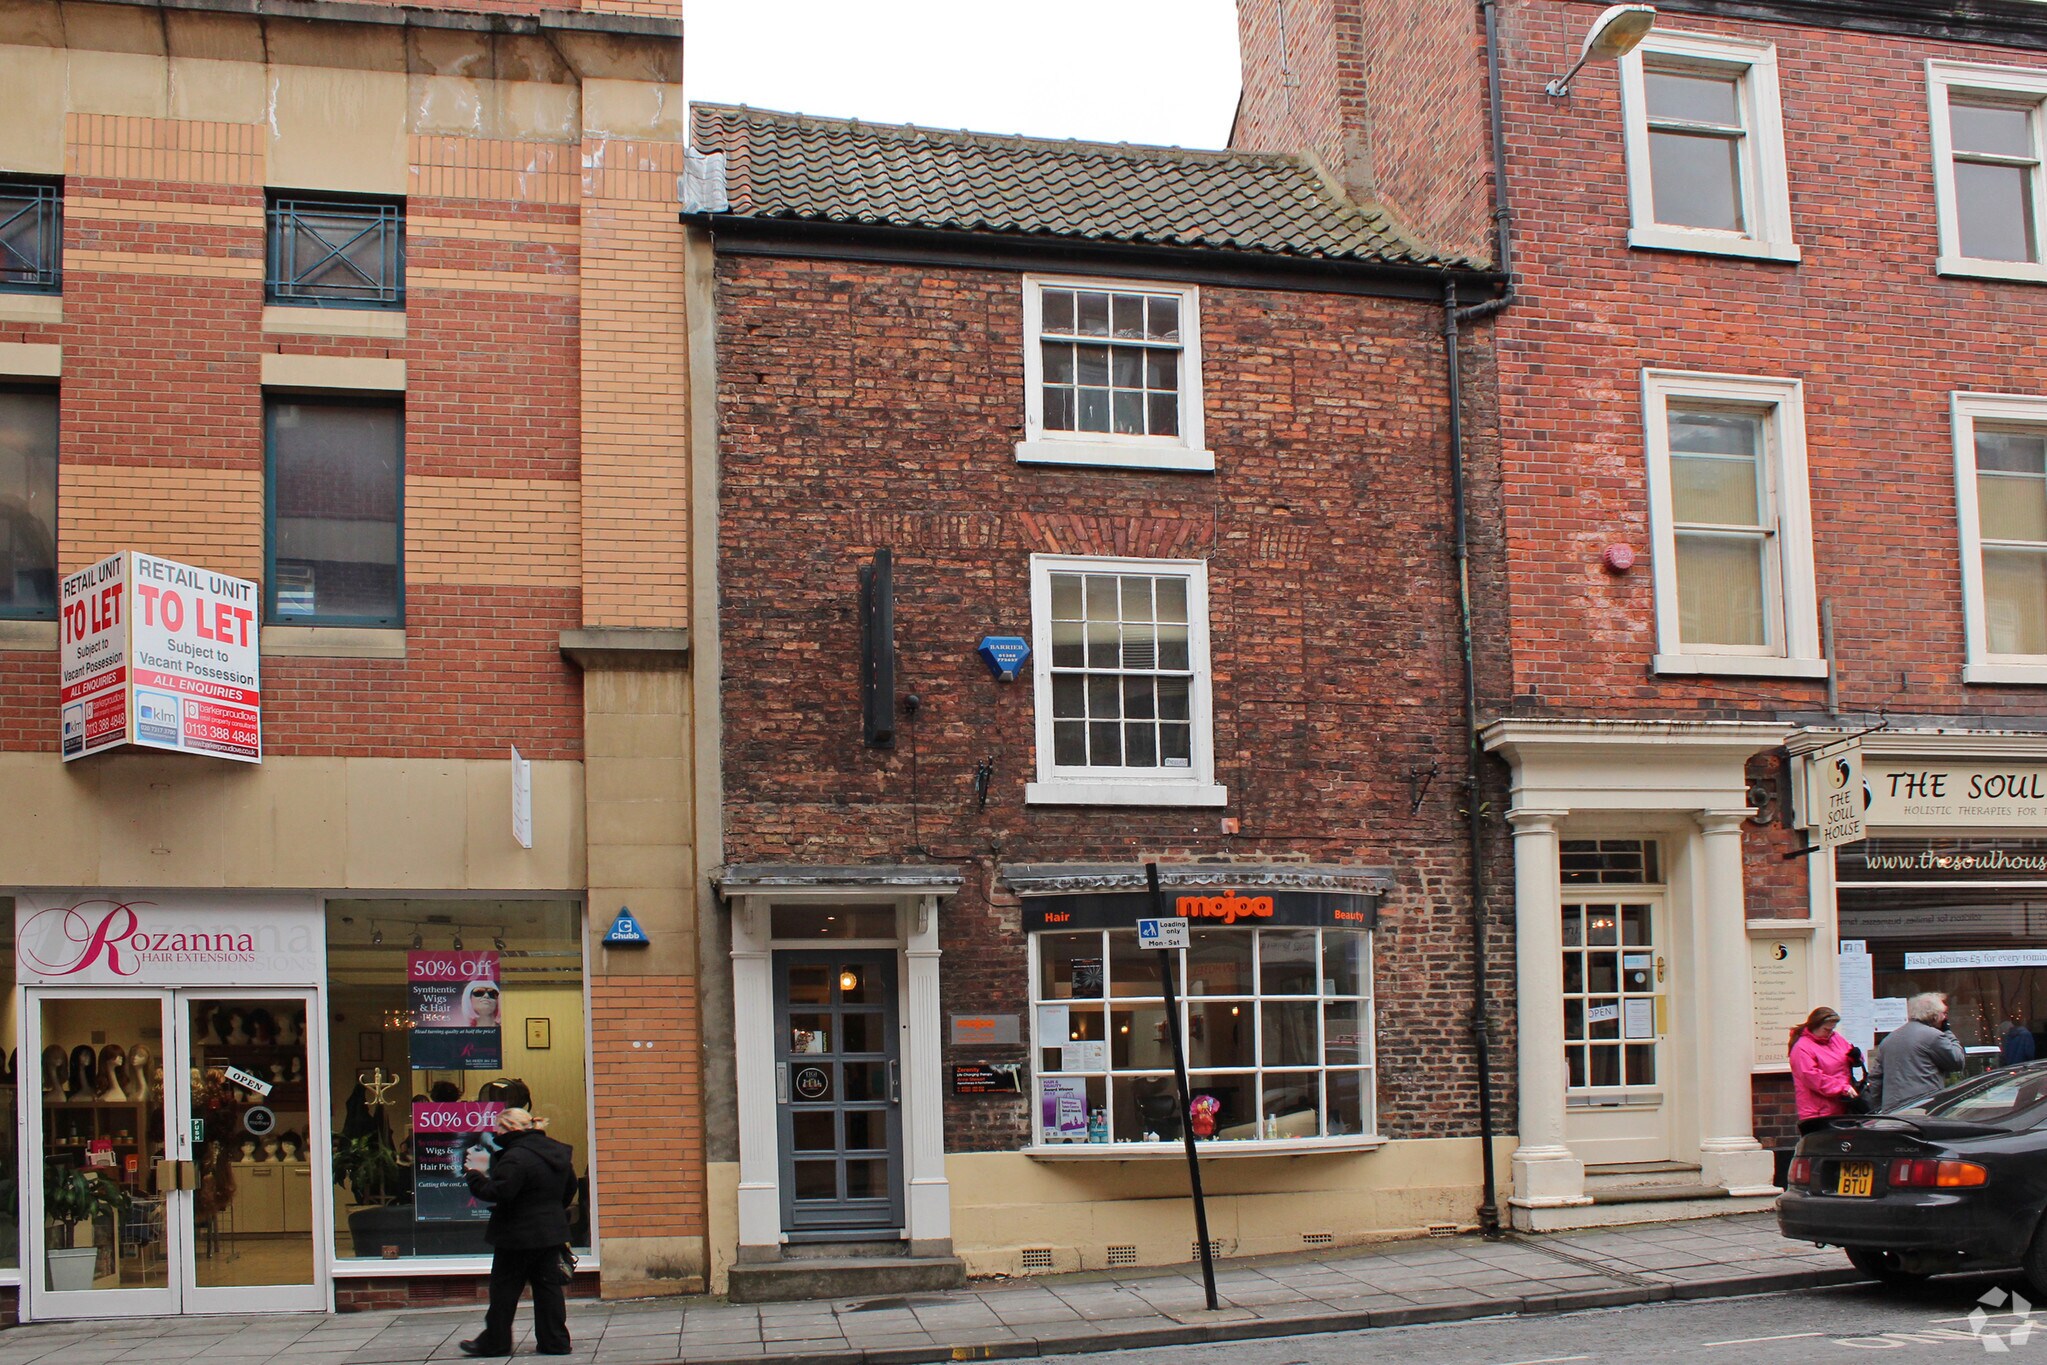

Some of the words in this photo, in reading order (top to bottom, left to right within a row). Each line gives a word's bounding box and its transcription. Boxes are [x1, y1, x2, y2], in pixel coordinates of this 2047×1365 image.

[65, 570, 96, 598] RETAIL
[99, 557, 121, 582] UNIT
[138, 558, 204, 590] RETAIL
[210, 576, 250, 601] UNIT
[64, 600, 86, 644] TO
[92, 582, 122, 634] LET
[138, 584, 184, 632] TO
[196, 597, 253, 648] LET
[77, 641, 101, 659] Subject
[102, 639, 109, 650] to
[168, 638, 214, 660] Subject
[218, 650, 229, 662] to
[64, 666, 85, 682] Vacant
[86, 652, 123, 674] Possession
[140, 652, 182, 672] Vacant
[186, 661, 254, 685] Possession
[70, 687, 81, 698] ALL
[83, 672, 117, 694] ENQUIRIES
[154, 675, 176, 688] ALL
[179, 680, 243, 700] ENQUIRIES
[154, 707, 176, 723] klm
[200, 704, 256, 722] barkerproudlove
[86, 722, 97, 736] 0113
[99, 719, 109, 732] 388
[110, 712, 125, 728] 4848
[211, 718, 230, 726] property
[232, 720, 256, 730] consultants
[185, 722, 208, 737] 0113
[210, 724, 230, 740] 388
[232, 730, 257, 745] 4848
[1886, 772, 1948, 799] THE
[1968, 773, 2045, 799] SOUL
[1830, 791, 1851, 808] THE
[1828, 805, 1855, 824] SOUL
[1904, 806, 1952, 815] HOLISTIC
[1958, 806, 2012, 816] THERAPIES
[2018, 806, 2037, 816] FOR
[1824, 820, 1860, 841] HOUSE
[1176, 889, 1274, 924] mojoa
[1045, 912, 1070, 922] Hair
[1334, 909, 1364, 922] Beauty
[1159, 921, 1186, 929] Loading
[17, 900, 255, 976] Rozanna
[142, 953, 174, 963] HAIR
[176, 953, 255, 963] EXTENSIONS
[1907, 956, 1925, 965] Fish
[1928, 956, 1967, 966] pedicures
[1970, 956, 1981, 964] £5
[1984, 954, 1995, 962] for
[1998, 955, 2020, 964] every
[414, 960, 456, 976] 50%
[460, 960, 492, 976] Off
[413, 986, 456, 995] Synthentic
[420, 1004, 428, 1012] &
[430, 1004, 451, 1012] Hair
[423, 995, 447, 1004] Wigs
[1588, 1008, 1612, 1019] OPEN
[232, 1073, 263, 1090] OPEN
[420, 1112, 461, 1127] 50%
[466, 1111, 497, 1127] Off
[426, 1147, 445, 1155] Wigs
[1843, 1162, 1870, 1177] M210
[1843, 1178, 1867, 1194] BTU
